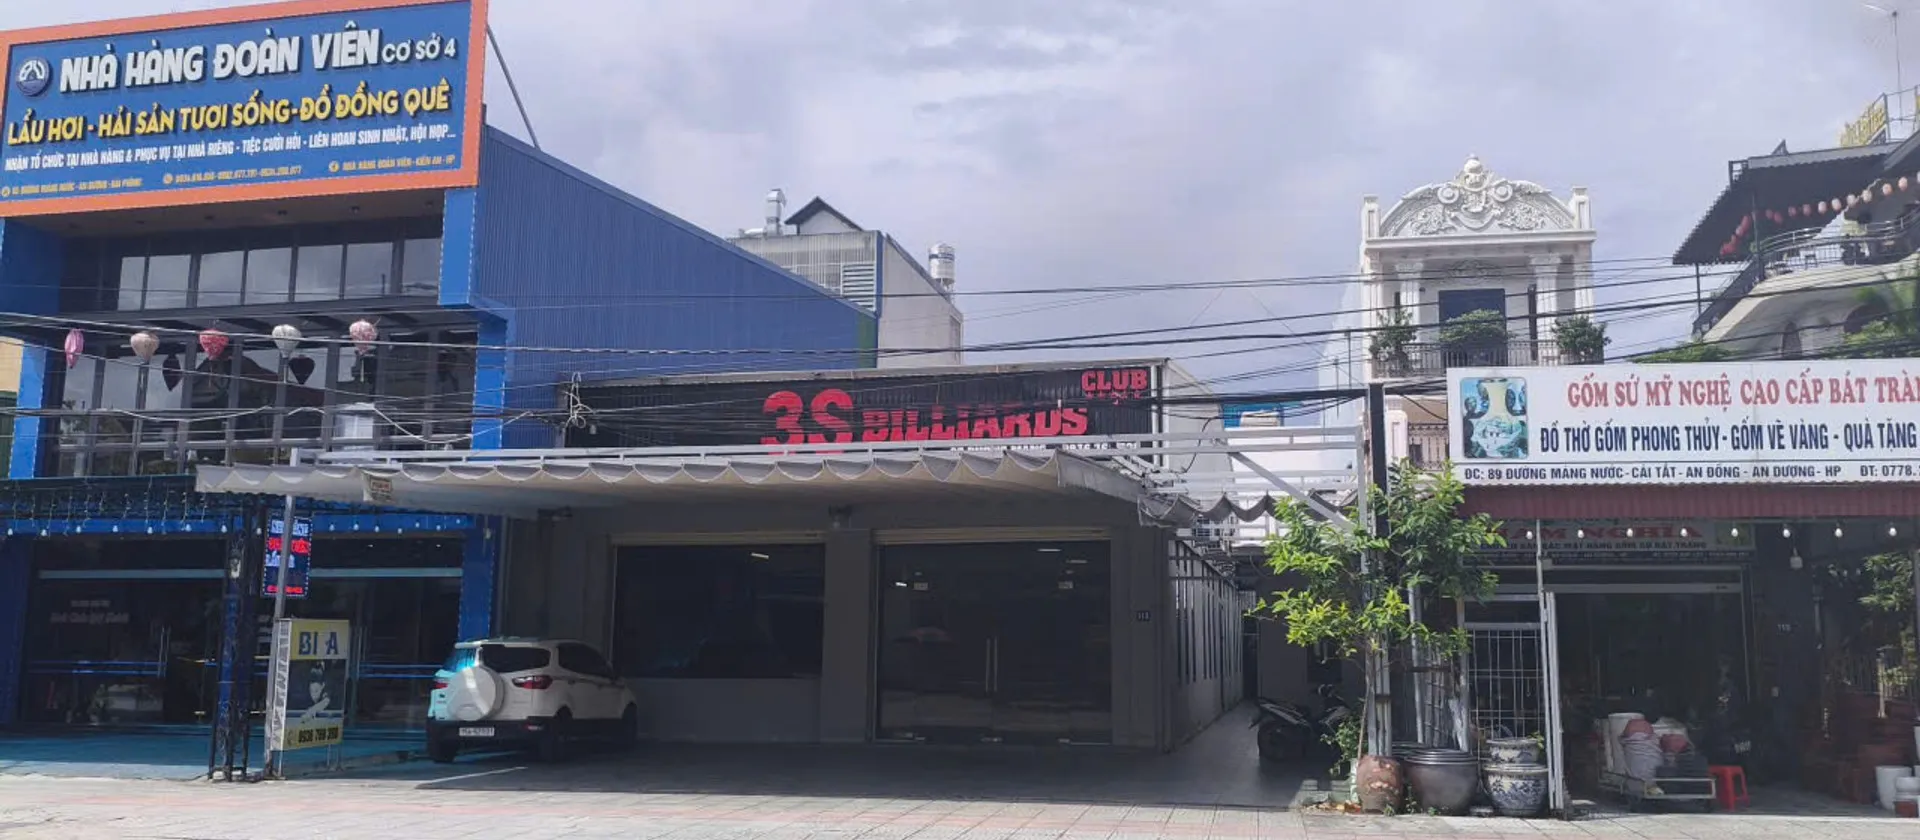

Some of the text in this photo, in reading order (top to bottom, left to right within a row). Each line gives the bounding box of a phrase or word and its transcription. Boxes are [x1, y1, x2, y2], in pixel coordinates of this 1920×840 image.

[60, 20, 457, 93] NHÀ HÀNG ĐOÀN VIÊN CƠ SỞ 4
[8, 107, 45, 146] LẨU
[48, 115, 84, 142] HƠI
[98, 105, 132, 137] HẢI
[135, 102, 175, 135] SẢN
[180, 103, 228, 131] TƯƠI
[335, 80, 398, 117] ĐỒNG
[403, 77, 450, 117] QUÊ
[4, 153, 29, 173] NHẬN
[42, 151, 65, 168] CHỨC
[66, 152, 80, 170] TẠI
[80, 149, 99, 166] NHÀ
[100, 147, 124, 164] HÀNG
[126, 148, 133, 163] &
[134, 146, 158, 164] PHỤC
[160, 145, 171, 163] VỤ
[173, 144, 186, 162] TẠI
[187, 140, 206, 158] NHÀ
[207, 138, 234, 156] RIÊNG
[242, 136, 261, 156] TIỆC
[263, 133, 284, 152] CƯỚI
[285, 131, 302, 150] HỎI
[308, 131, 330, 149] LIÊN
[331, 131, 356, 148] HOAN
[358, 128, 381, 145] SINH
[410, 122, 427, 144] HỘI
[1082, 370, 1148, 391] CLUB
[1567, 367, 1920, 413] GỐM SỨ MỸ NGHỆ CAO CẤP BÁT TRÀ
[760, 388, 1088, 456] 3S BILLIARDS
[1540, 420, 1559, 452] ĐỒ
[1563, 419, 1590, 452] THỜ
[1594, 418, 1627, 452] GỐM
[1631, 425, 1680, 451] PHONG
[1685, 416, 1720, 450] THỦY
[1731, 416, 1763, 450] GỐM
[1789, 418, 1829, 450] VÀNG
[1843, 417, 1874, 452] QUÀ
[1877, 417, 1917, 452] TẶNG
[1465, 467, 1484, 480] ĐC:
[1488, 467, 1502, 480] 89
[1506, 463, 1546, 480] ĐƯỜNG
[1686, 466, 1703, 478] AN
[1752, 466, 1769, 478] AN
[1825, 466, 1842, 477] HP
[1860, 465, 1878, 477] ĐT:
